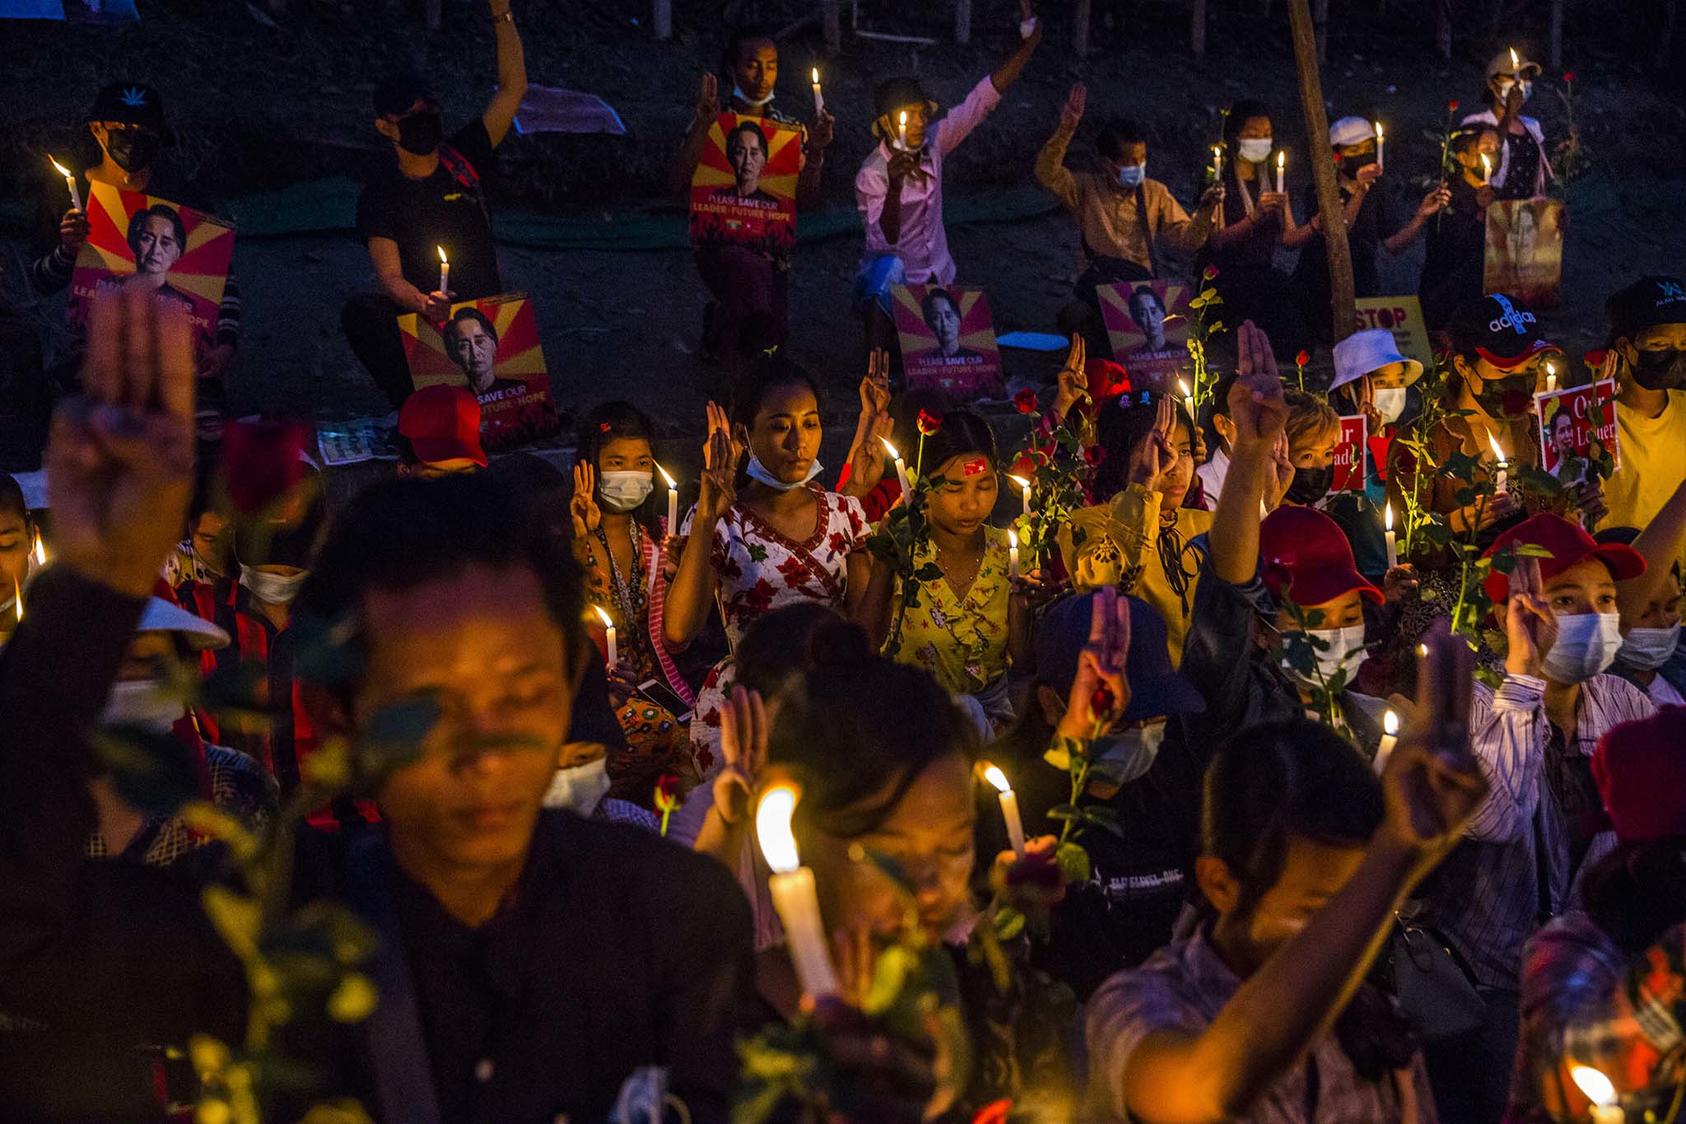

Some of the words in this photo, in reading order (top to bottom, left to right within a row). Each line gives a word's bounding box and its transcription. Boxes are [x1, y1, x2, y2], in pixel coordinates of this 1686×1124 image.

[738, 197, 761, 209] SAVE
[762, 200, 778, 210] OUR
[1354, 306, 1406, 331] STOP
[477, 389, 504, 405] SAVE
[505, 384, 527, 399] OUR
